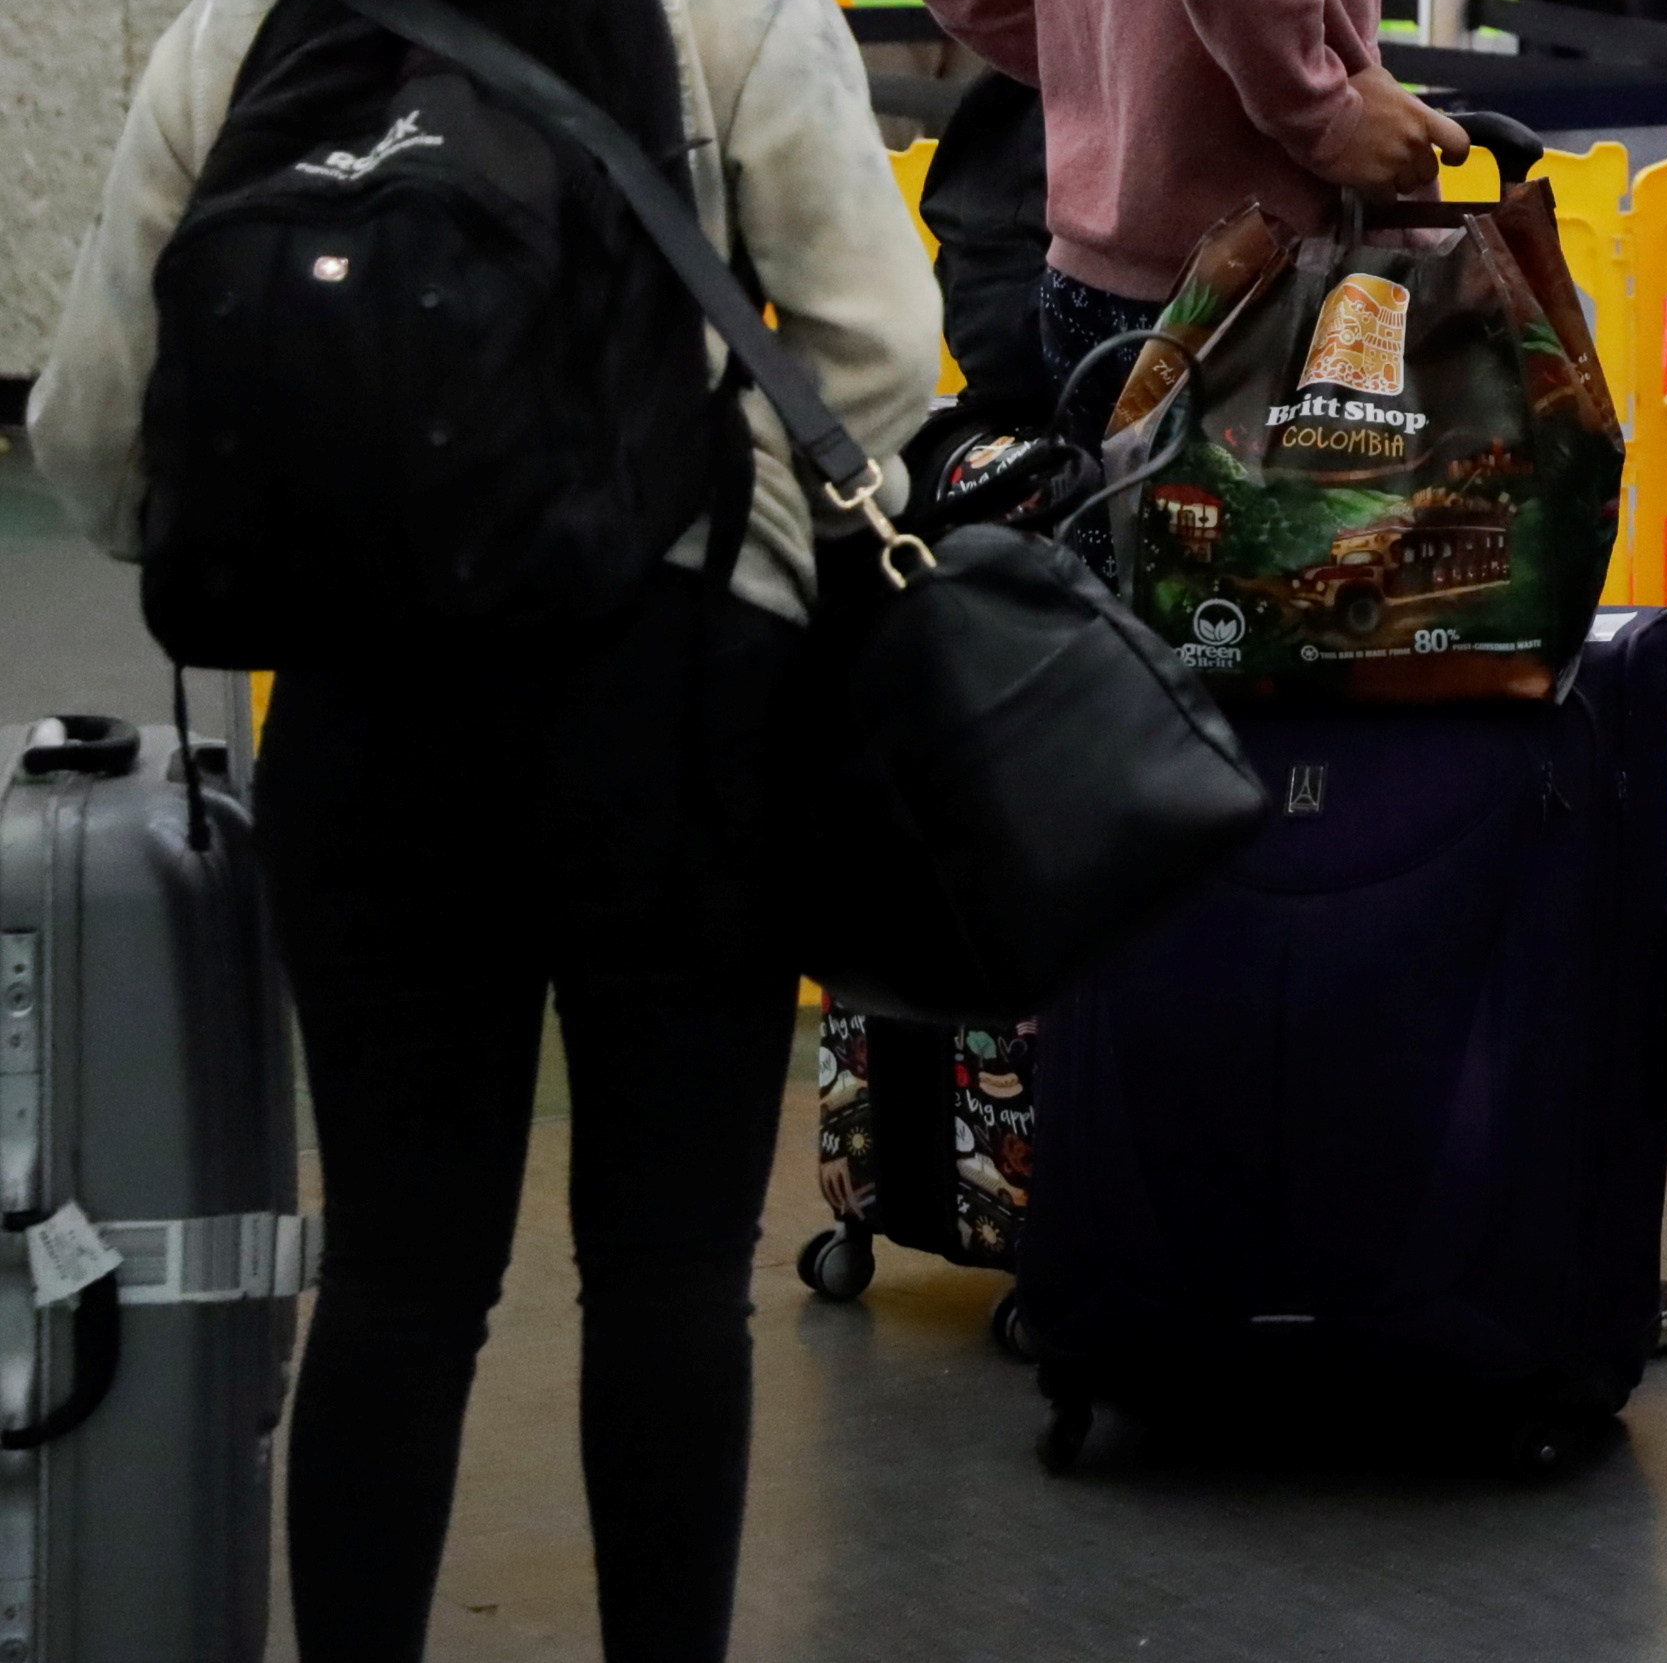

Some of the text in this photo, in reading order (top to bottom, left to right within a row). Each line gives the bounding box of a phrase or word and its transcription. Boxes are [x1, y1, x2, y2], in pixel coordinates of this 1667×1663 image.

[1265, 393, 1426, 435] Britt Shop
[966, 1089, 995, 1126] big
